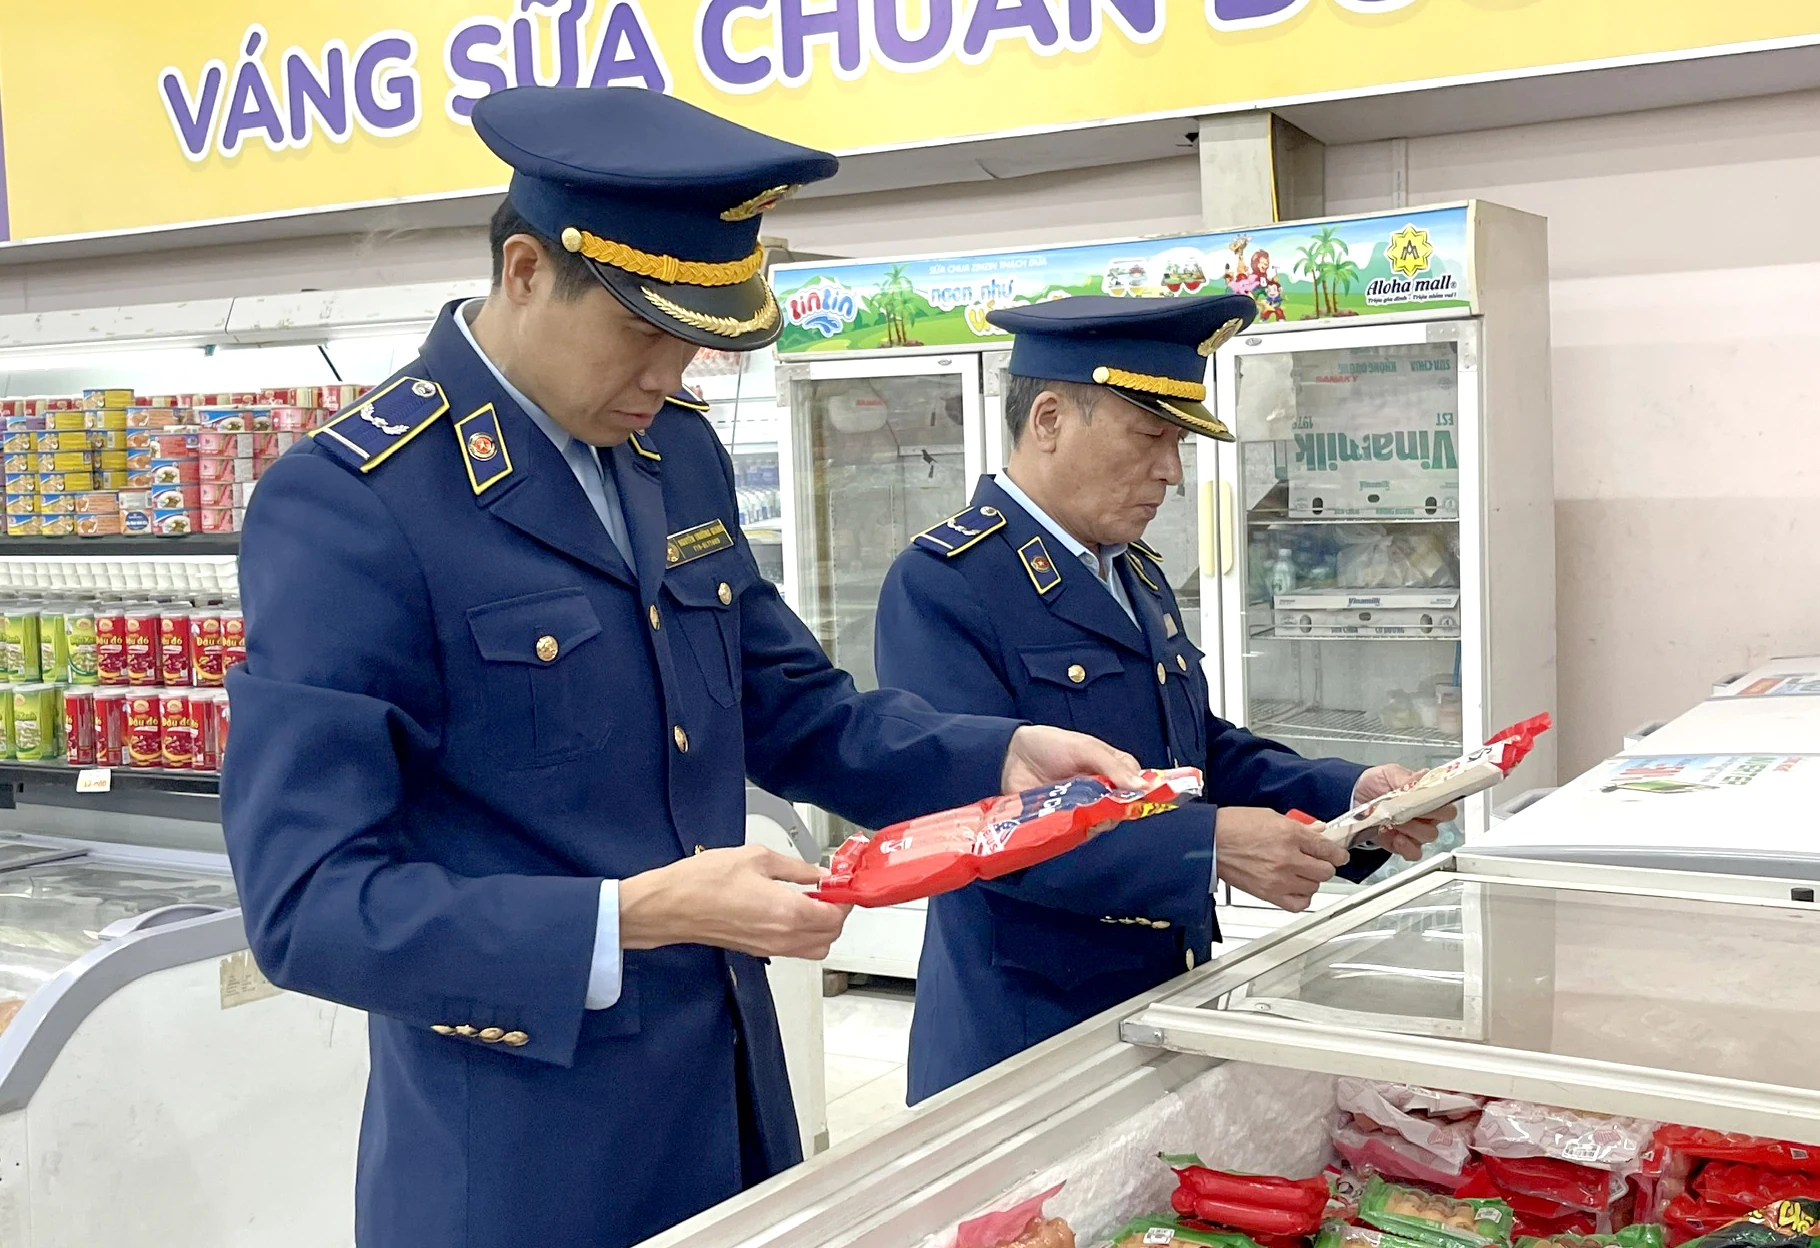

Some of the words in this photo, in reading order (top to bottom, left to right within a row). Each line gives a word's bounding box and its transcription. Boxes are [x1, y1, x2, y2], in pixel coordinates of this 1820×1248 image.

[163, 31, 417, 155] VÁNG
[1366, 278, 1411, 296] Aloha
[1435, 412, 1454, 426] EST
[1294, 430, 1458, 471] Vinamilk
